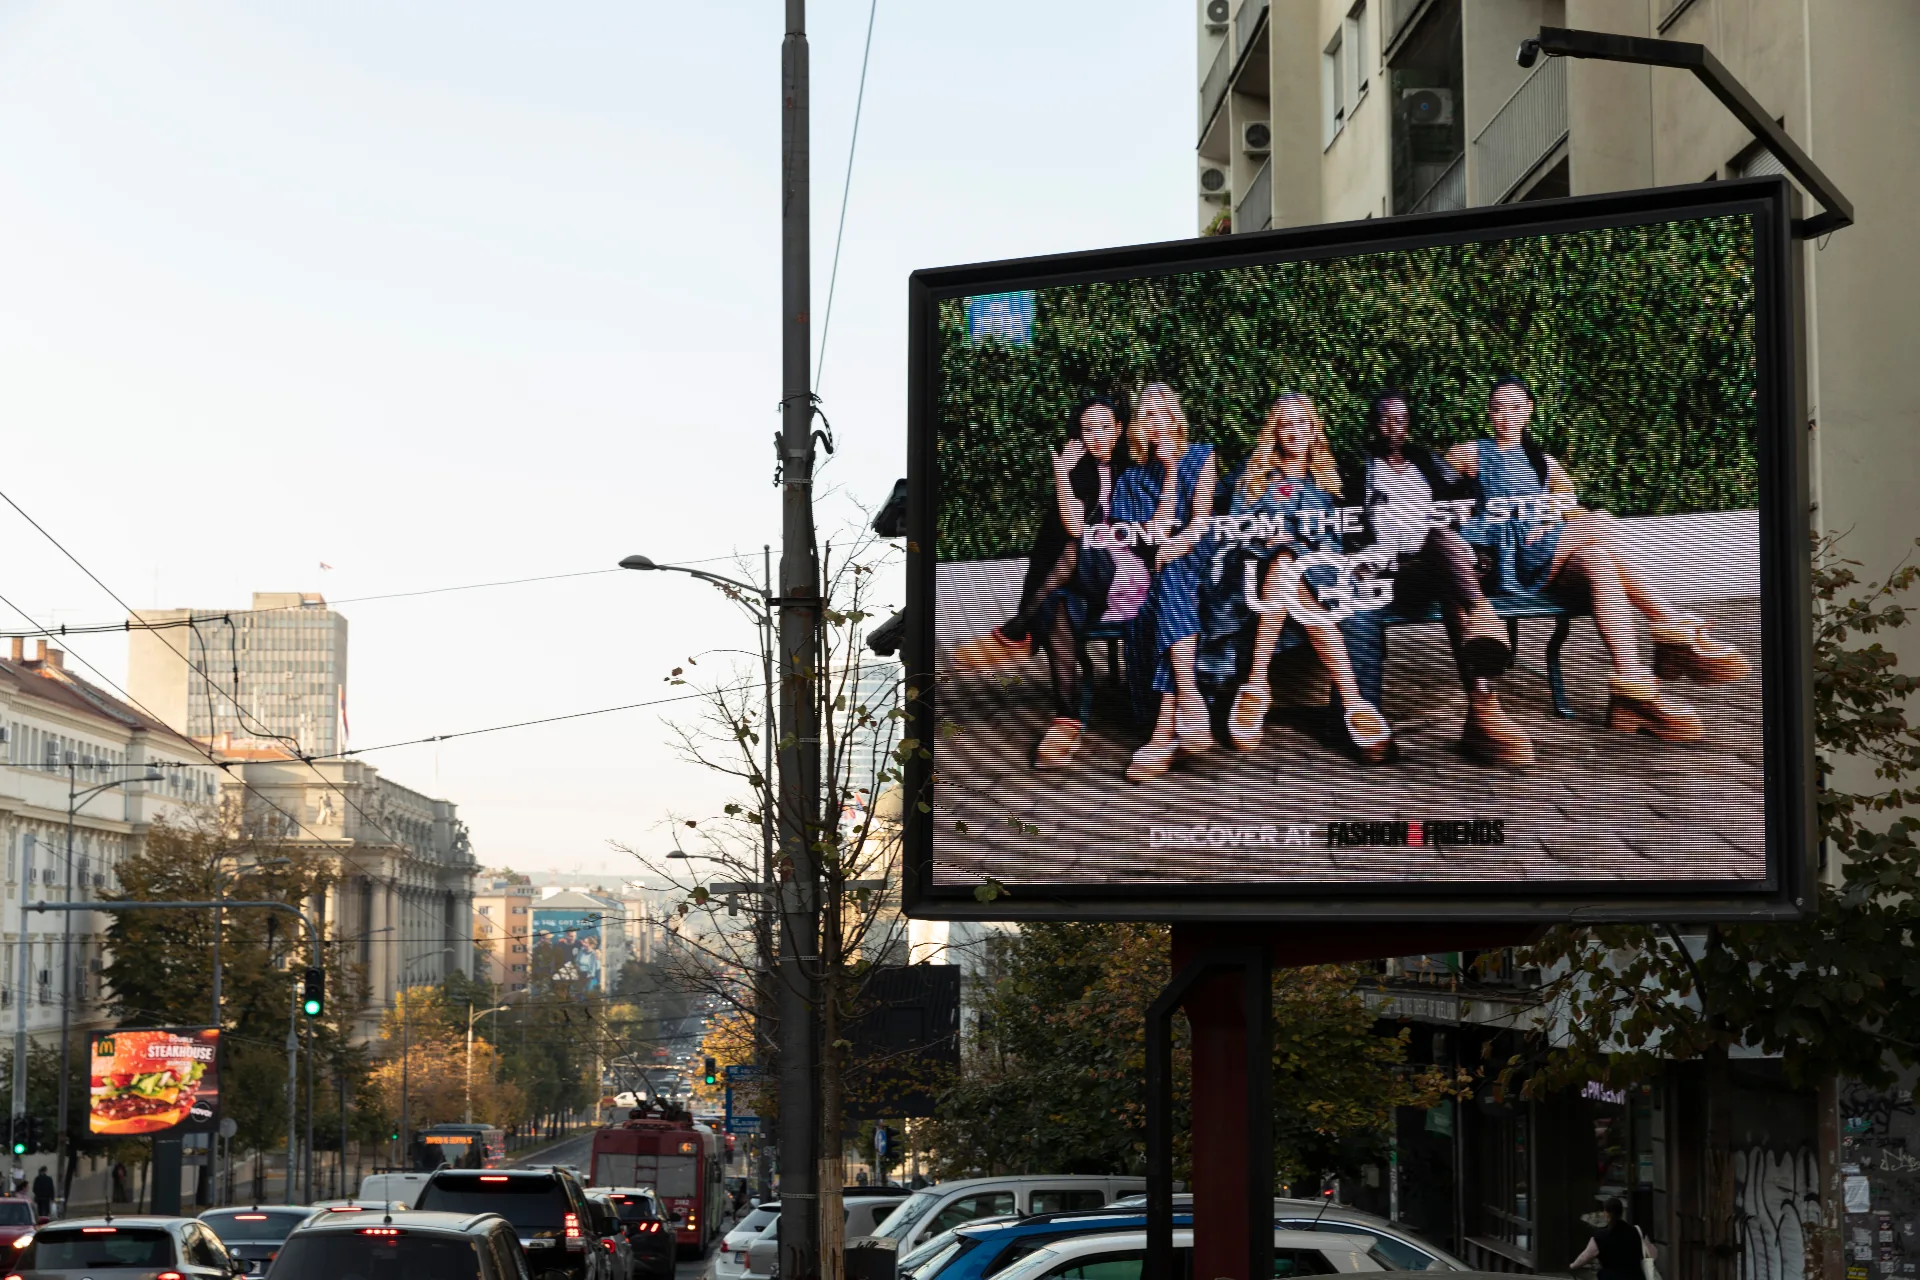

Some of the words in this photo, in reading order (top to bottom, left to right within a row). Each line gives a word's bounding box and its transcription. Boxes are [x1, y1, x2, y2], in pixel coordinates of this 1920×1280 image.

[1485, 493, 1576, 523] STEP
[1083, 517, 1182, 550] ICONIC
[1294, 505, 1364, 536] THE
[1150, 825, 1278, 848] DISCOVER
[1283, 823, 1317, 846] AT
[147, 1045, 213, 1060] STEAKHOUSE
